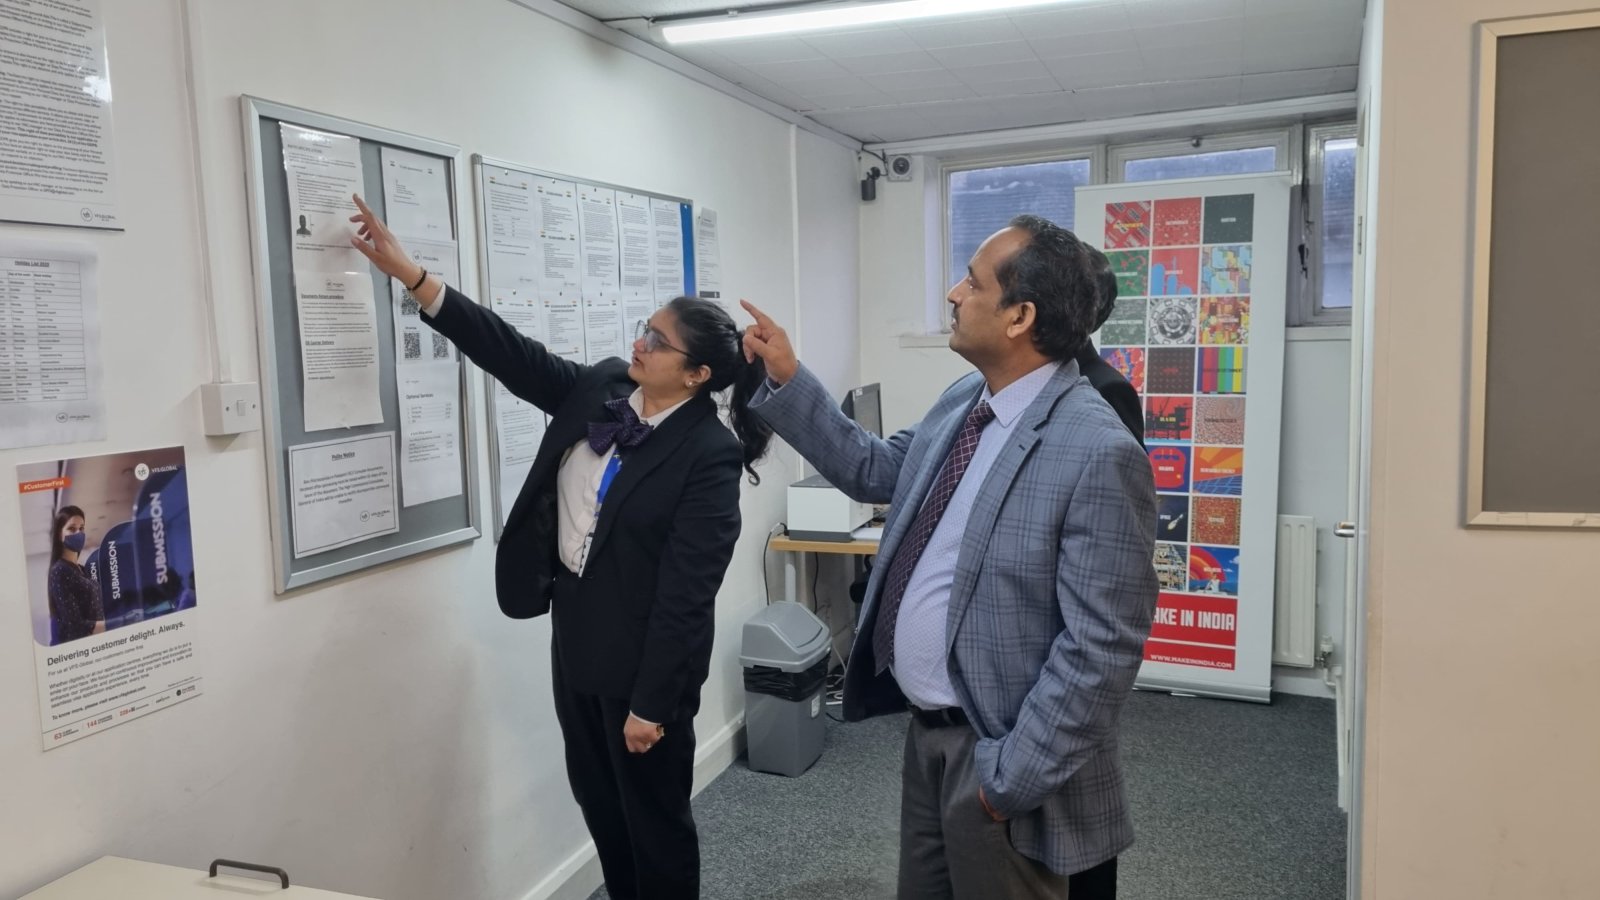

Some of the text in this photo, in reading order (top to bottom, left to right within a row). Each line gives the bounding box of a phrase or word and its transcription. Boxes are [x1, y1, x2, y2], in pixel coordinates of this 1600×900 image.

[24, 480, 64, 490] #CustomerFirst
[150, 492, 168, 585] SUBMISSION
[108, 540, 120, 600] SUBMISSION
[1154, 607, 1235, 631] AKE IN INDIA
[47, 621, 186, 666] Delivering customer delight. Always.
[1150, 654, 1232, 668] WWW.MAKEININDIA.COM
[54, 731, 61, 740] 63
